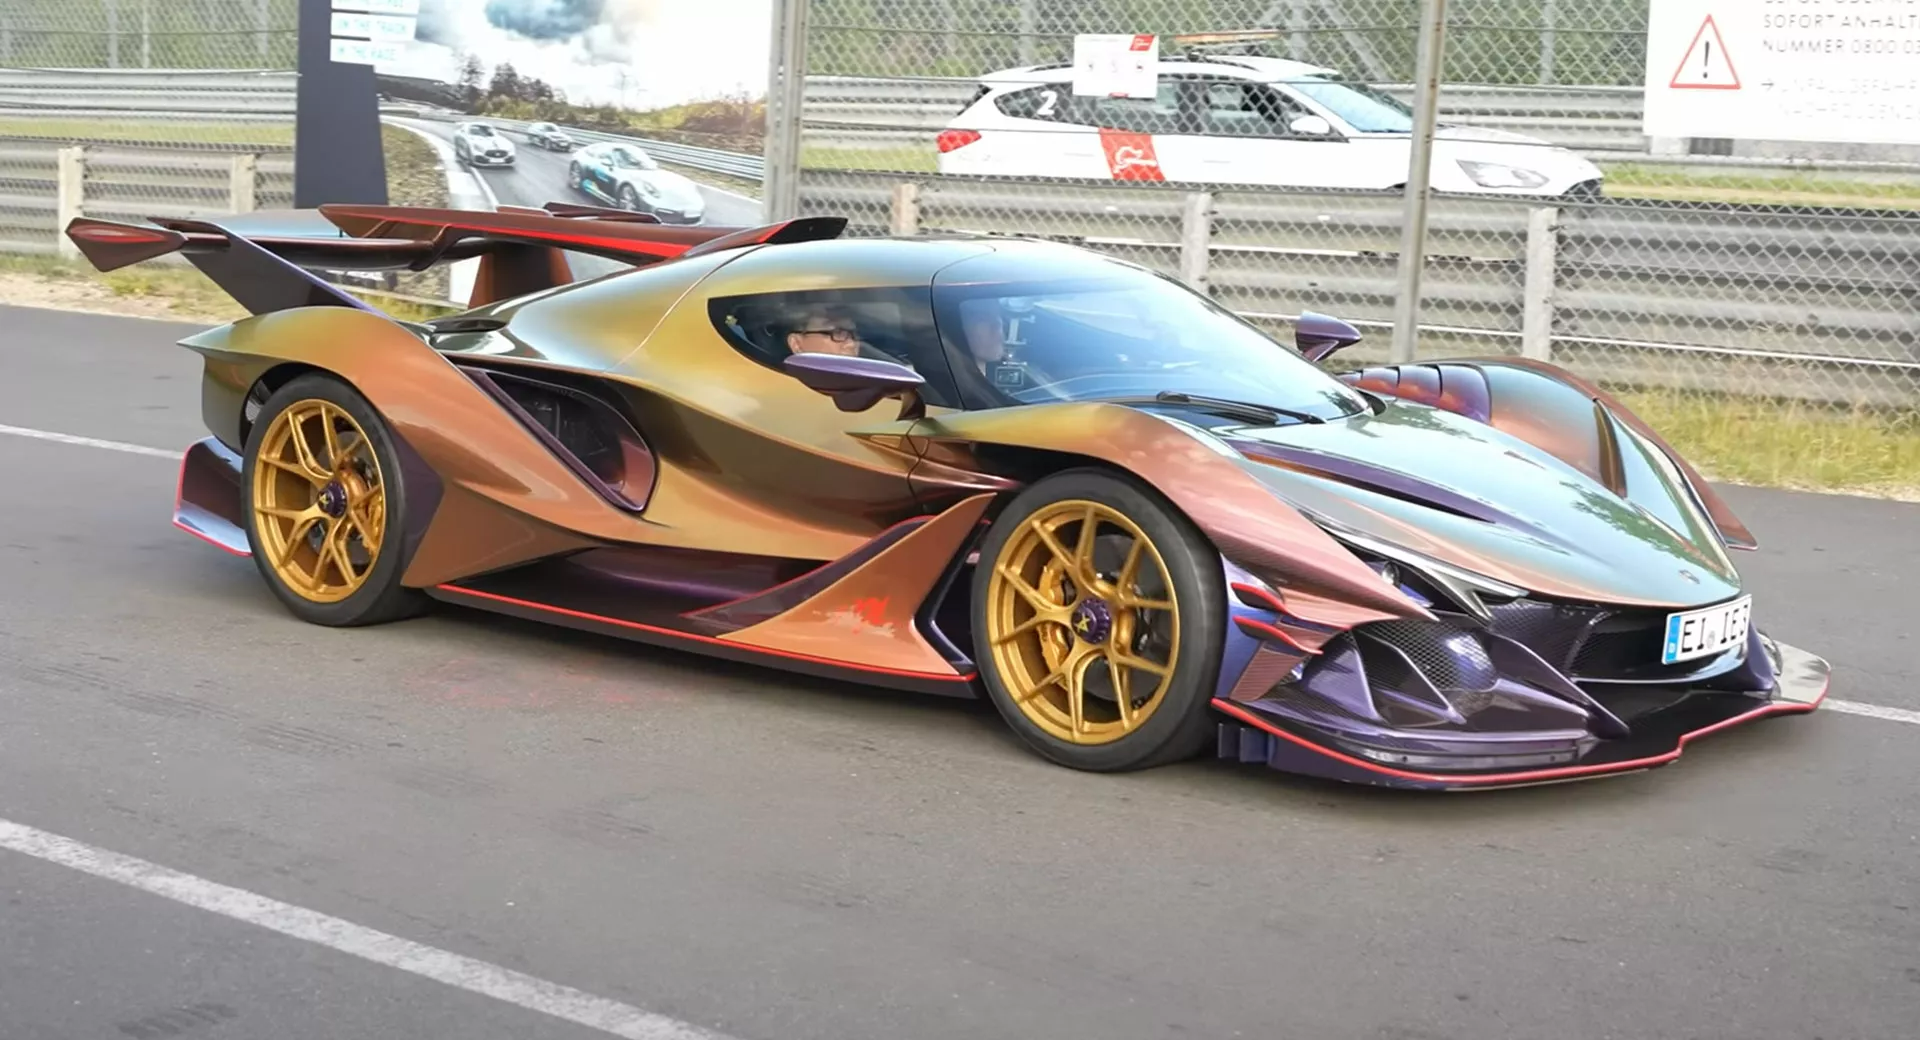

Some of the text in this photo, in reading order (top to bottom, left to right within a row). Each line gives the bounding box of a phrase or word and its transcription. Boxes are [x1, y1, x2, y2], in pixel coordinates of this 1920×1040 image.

[1763, 13, 1920, 29] SOFORT ANHALT
[1762, 38, 1845, 53] NUMMER
[1851, 39, 1898, 54] 0800
[1037, 91, 1058, 115] 2
